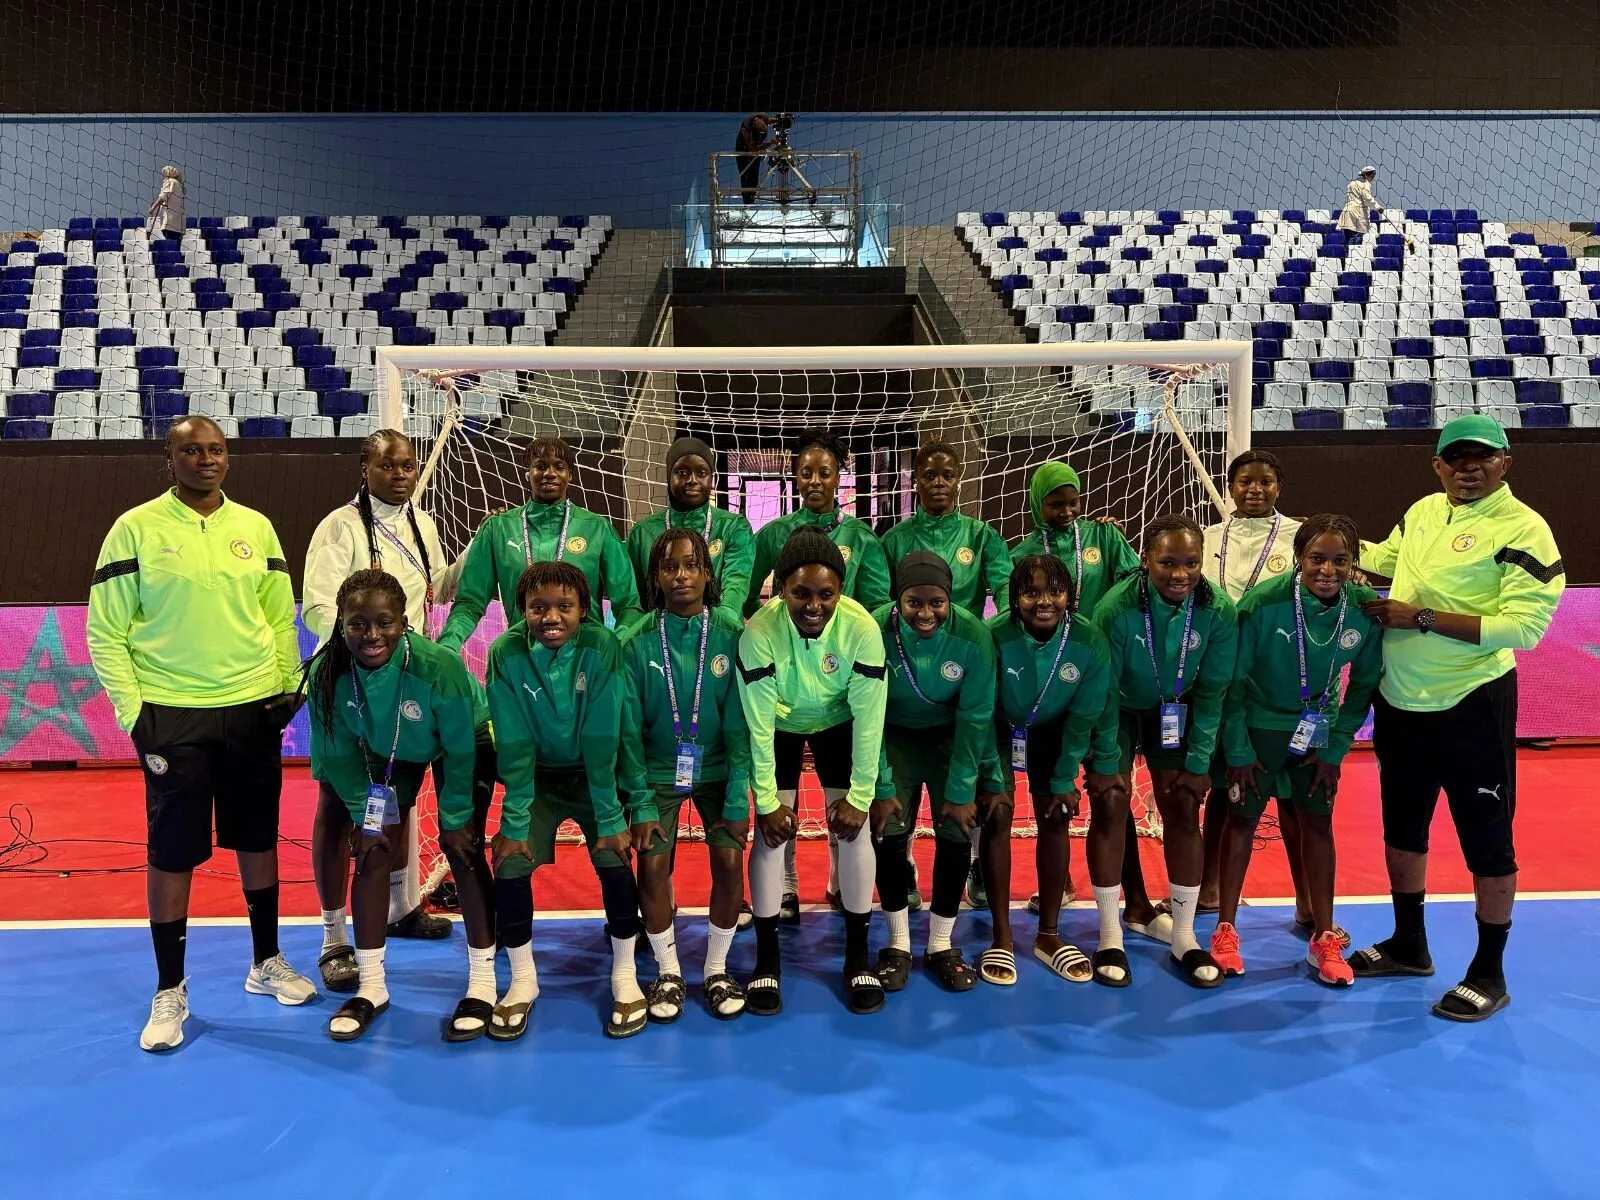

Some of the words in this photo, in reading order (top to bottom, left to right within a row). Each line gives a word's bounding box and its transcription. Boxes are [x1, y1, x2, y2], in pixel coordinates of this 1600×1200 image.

[747, 978, 778, 991] PUMA
[851, 975, 881, 987] PUMA
[1455, 986, 1487, 1006] UMA
